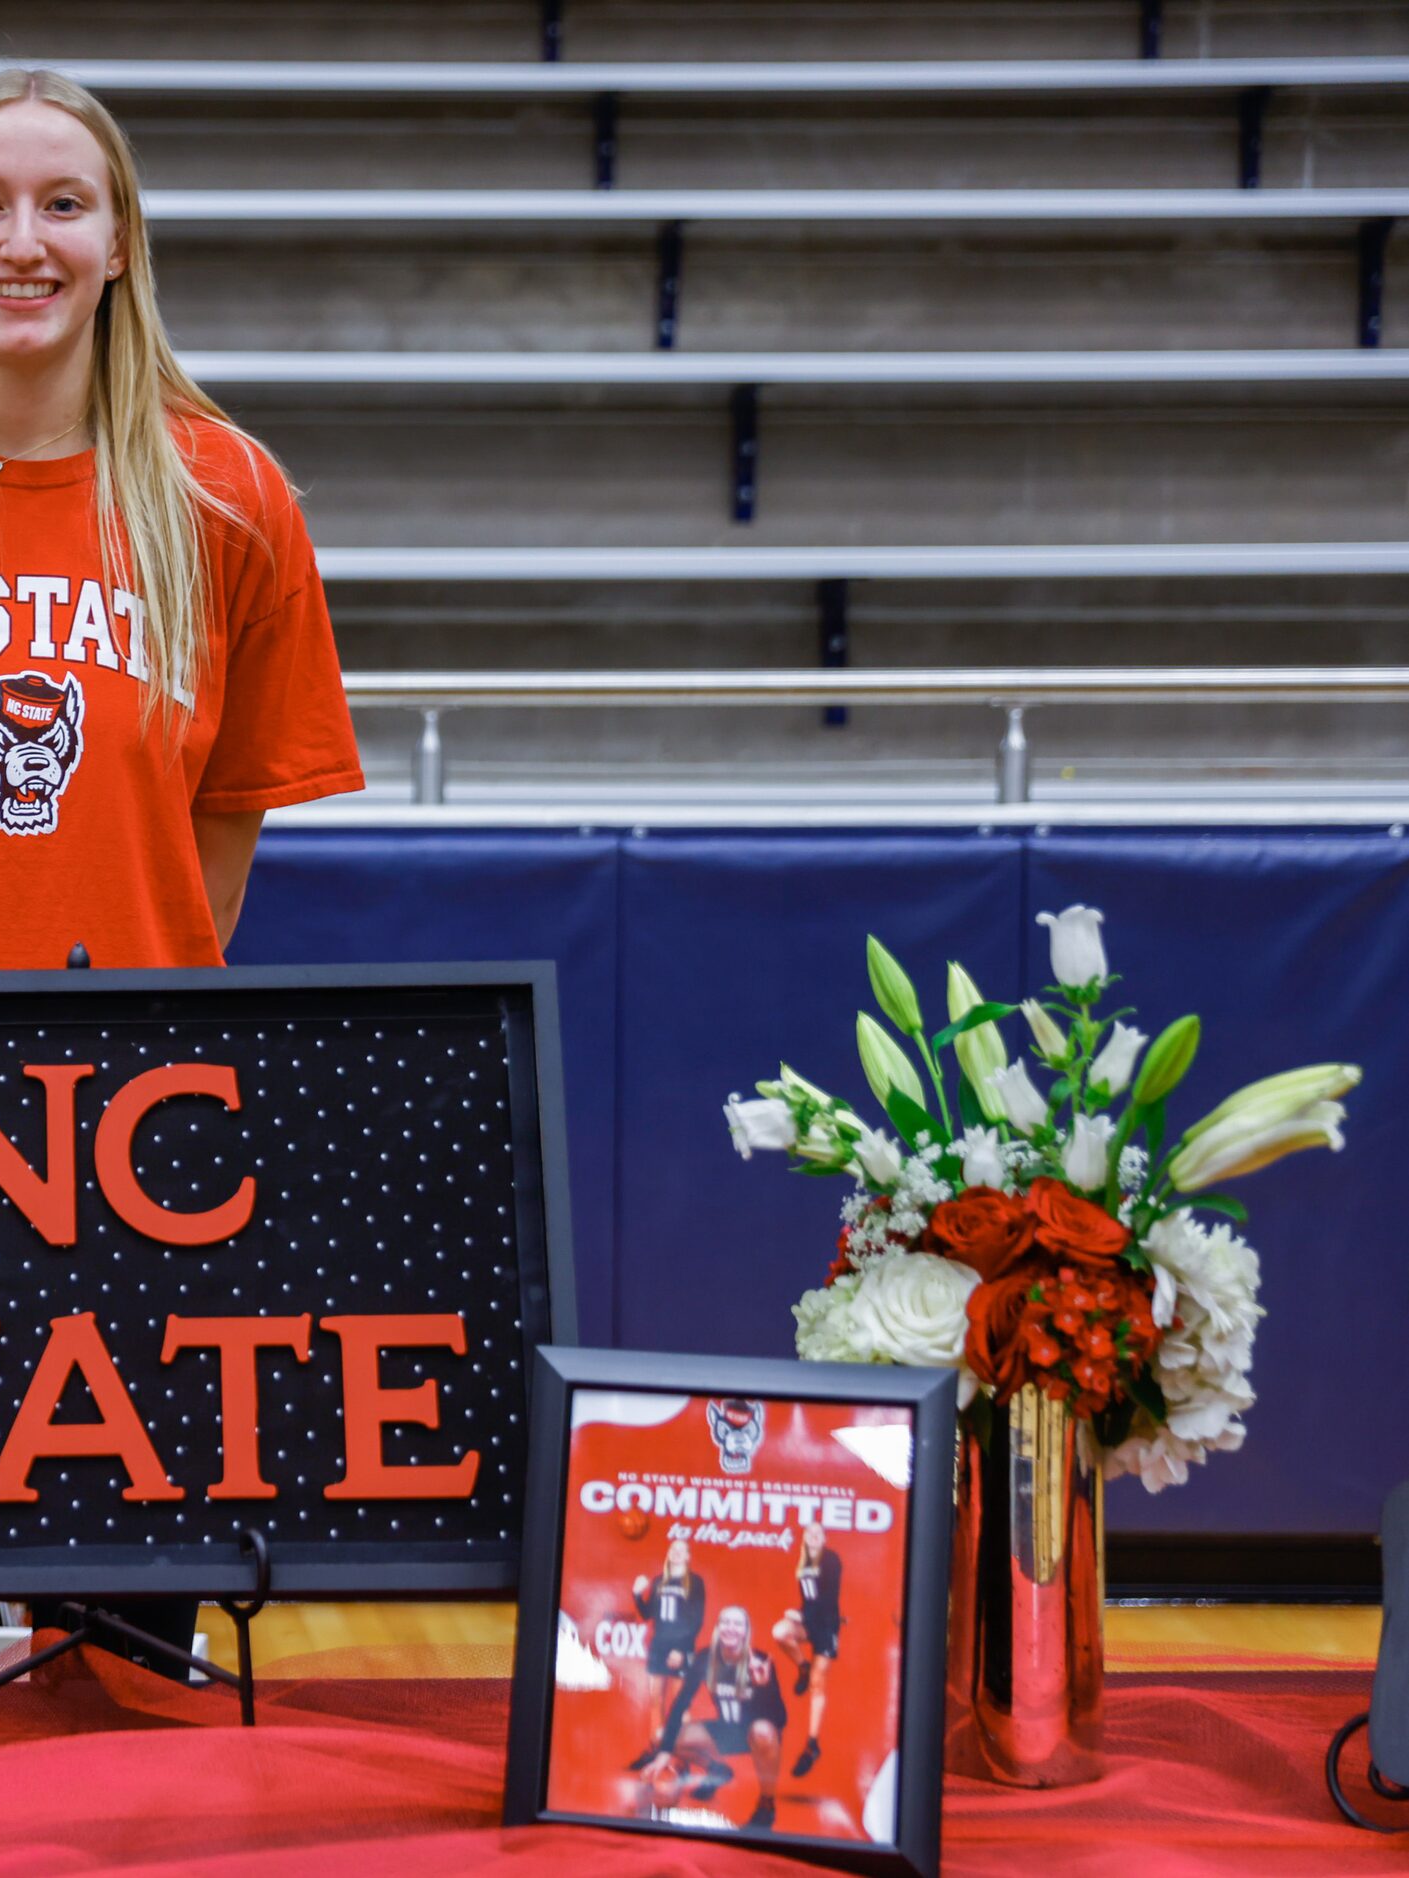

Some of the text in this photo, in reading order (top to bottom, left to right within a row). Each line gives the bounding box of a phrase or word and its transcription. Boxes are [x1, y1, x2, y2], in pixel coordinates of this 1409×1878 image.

[6, 698, 54, 721] NC STATE
[580, 1480, 893, 1532] COMMITTED
[667, 1521, 794, 1551] to the pack
[594, 1620, 648, 1659] COX
